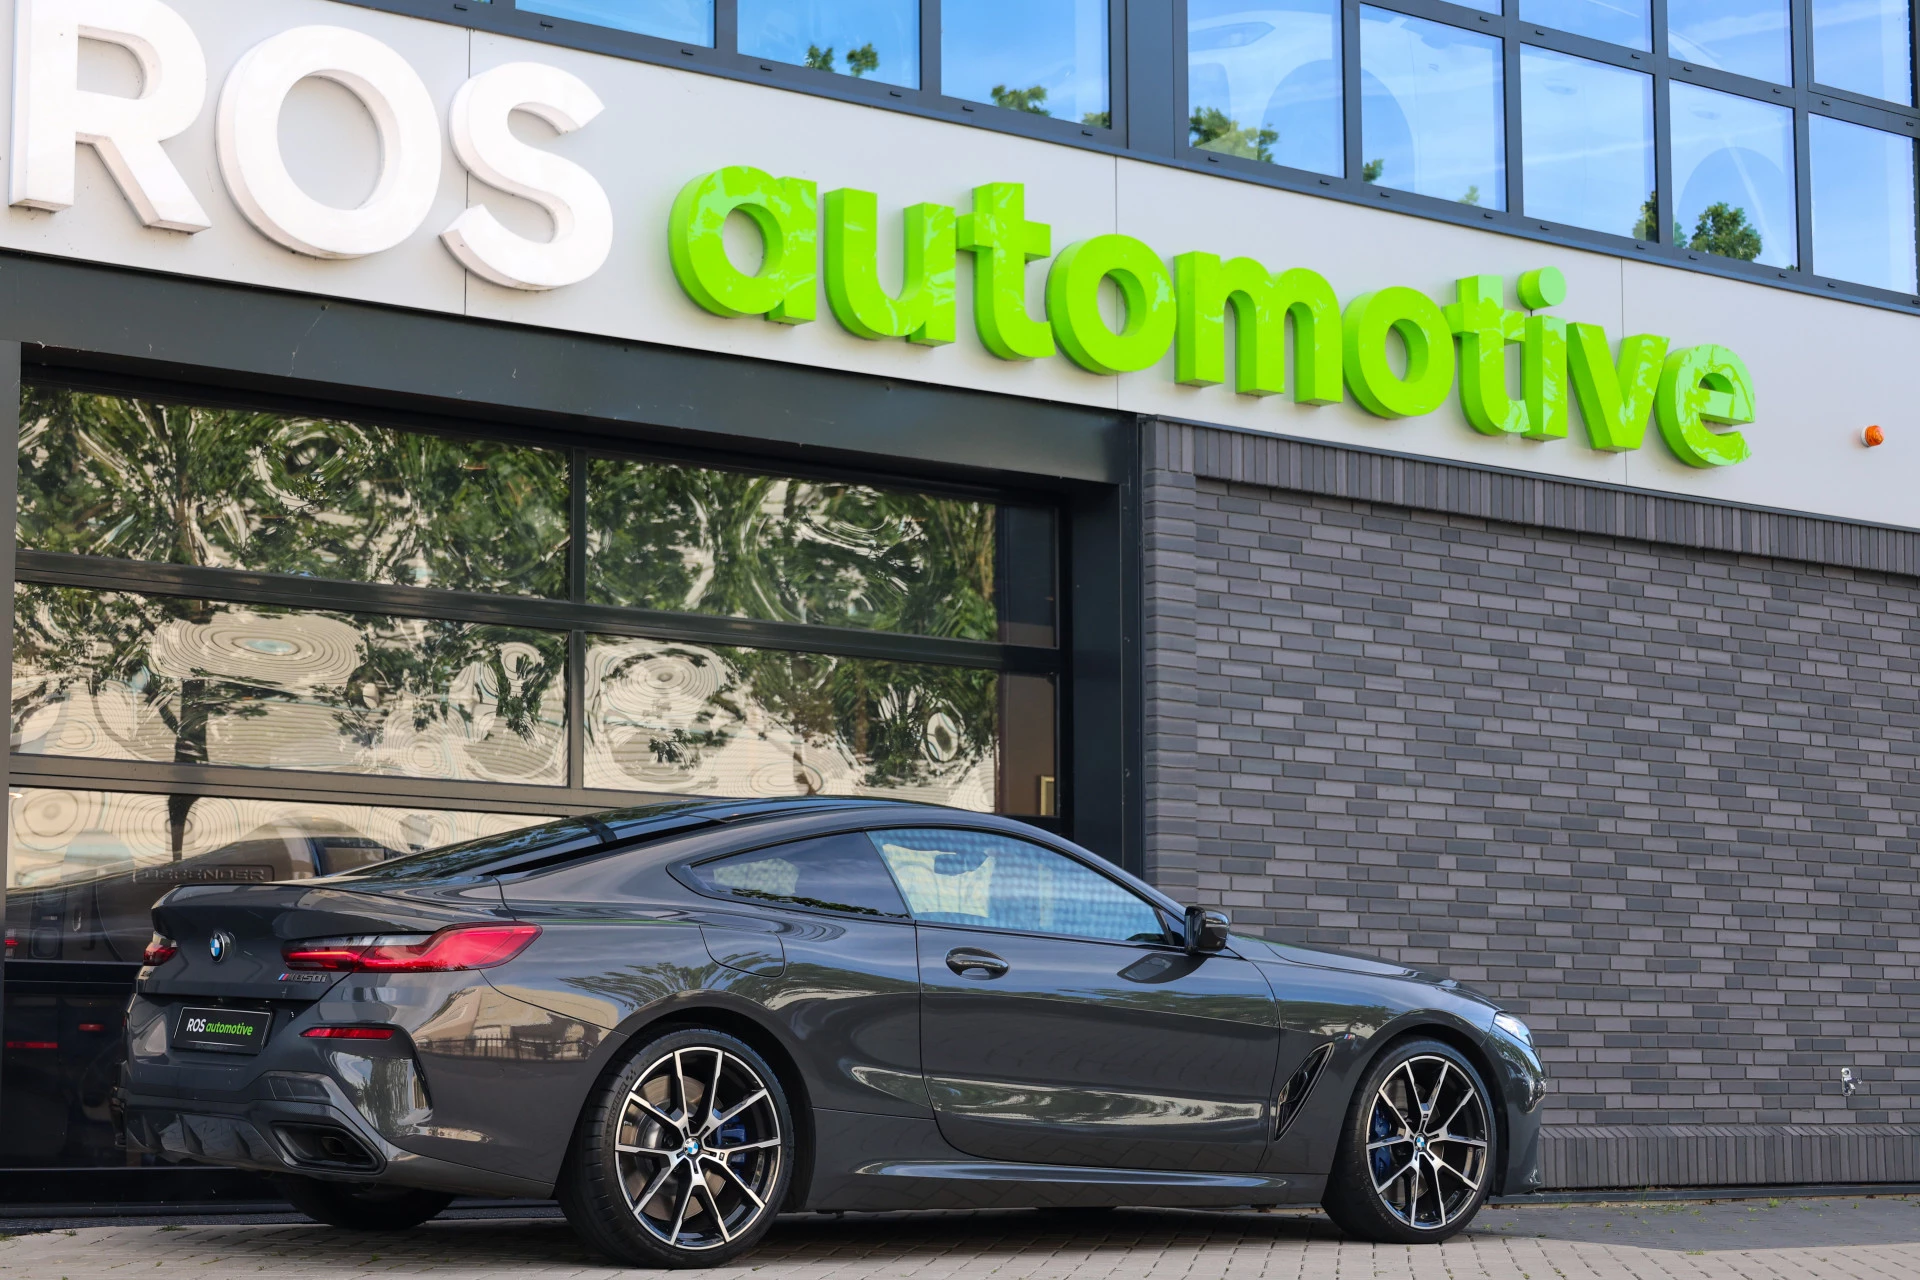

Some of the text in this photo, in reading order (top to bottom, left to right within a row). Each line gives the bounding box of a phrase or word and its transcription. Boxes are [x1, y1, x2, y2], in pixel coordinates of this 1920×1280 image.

[9, 0, 1756, 469] ROS automotive
[186, 1018, 254, 1036] ROS automotive
